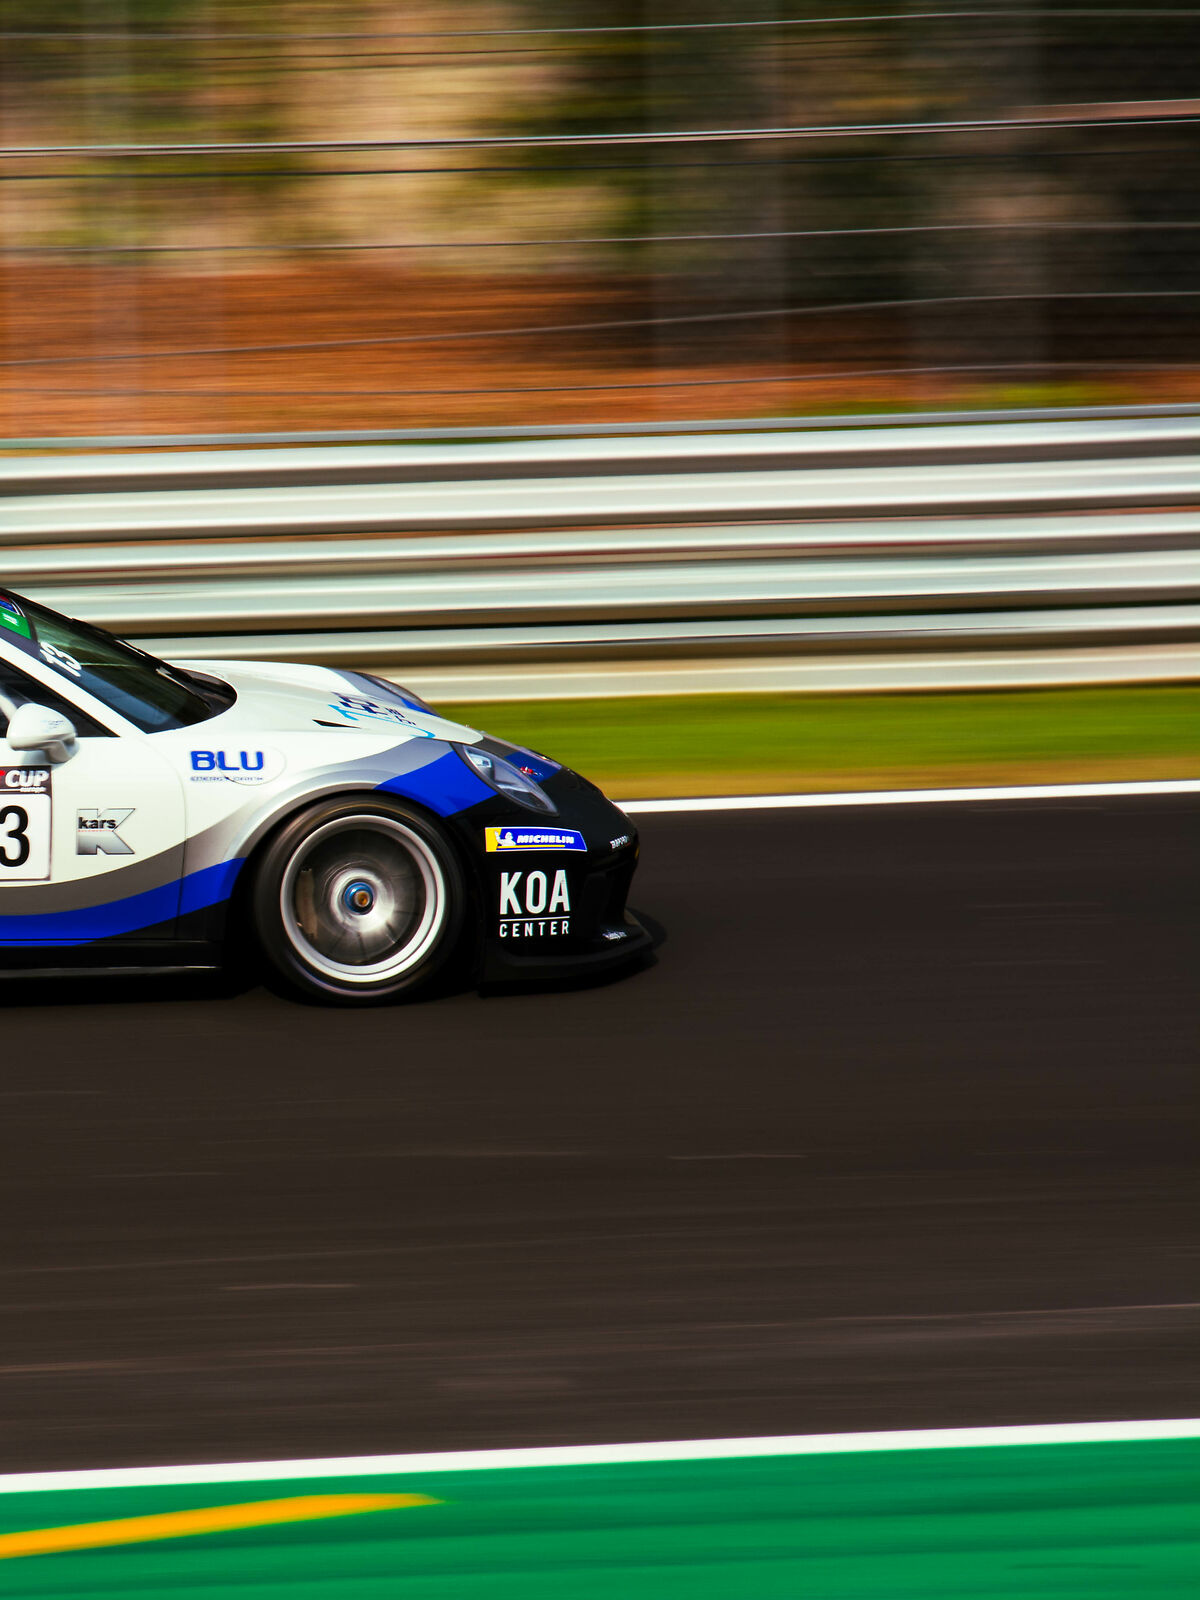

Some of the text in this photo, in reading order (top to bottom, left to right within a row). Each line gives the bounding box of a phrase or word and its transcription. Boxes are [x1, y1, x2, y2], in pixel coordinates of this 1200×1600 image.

[40, 641, 82, 677] 13
[190, 750, 264, 771] BLU
[5, 769, 50, 788] CUP
[78, 816, 116, 829] kars
[516, 834, 575, 844] MICHELIN
[500, 869, 571, 915] KOA
[500, 920, 569, 938] CENTER
